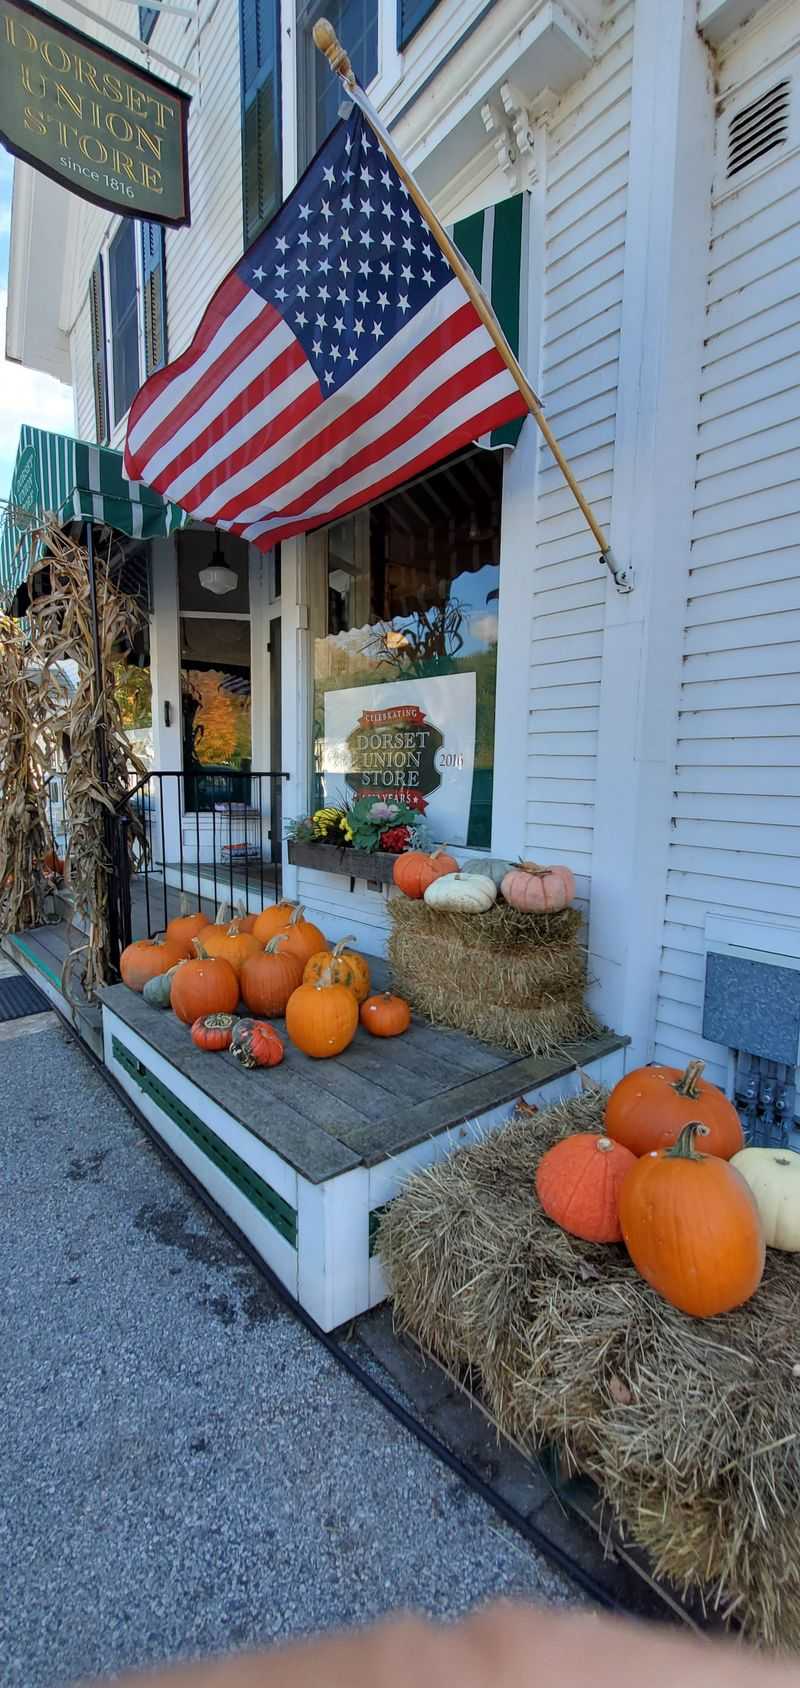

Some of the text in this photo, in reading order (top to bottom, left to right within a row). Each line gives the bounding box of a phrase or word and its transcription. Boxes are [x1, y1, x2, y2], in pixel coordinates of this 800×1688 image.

[5, 15, 174, 129] DORSET
[20, 63, 163, 161] UNION
[24, 105, 163, 194] STORE
[59, 156, 135, 198] since 1816
[364, 709, 417, 722] CELEBRATING
[357, 731, 430, 750] DORSET
[363, 751, 421, 768] UNION
[361, 770, 419, 787] STORE
